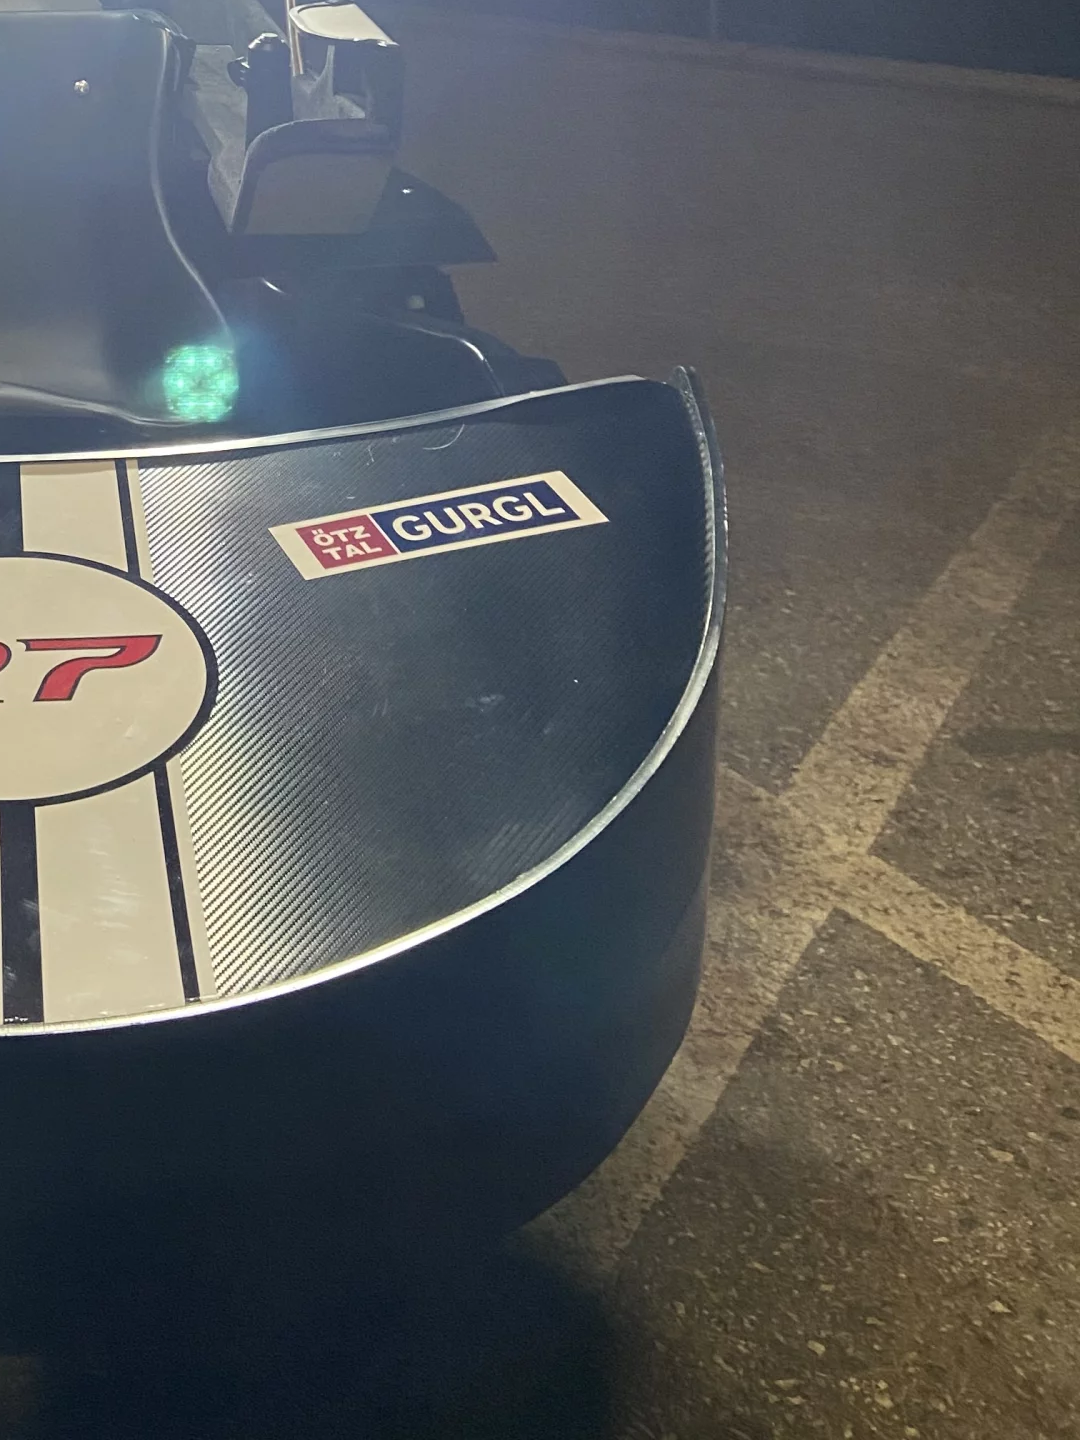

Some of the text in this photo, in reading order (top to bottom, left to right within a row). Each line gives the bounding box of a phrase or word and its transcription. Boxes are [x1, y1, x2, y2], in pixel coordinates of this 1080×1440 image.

[391, 491, 566, 542] GURGL
[311, 524, 372, 548] ÖTZ
[321, 539, 383, 561] TAL
